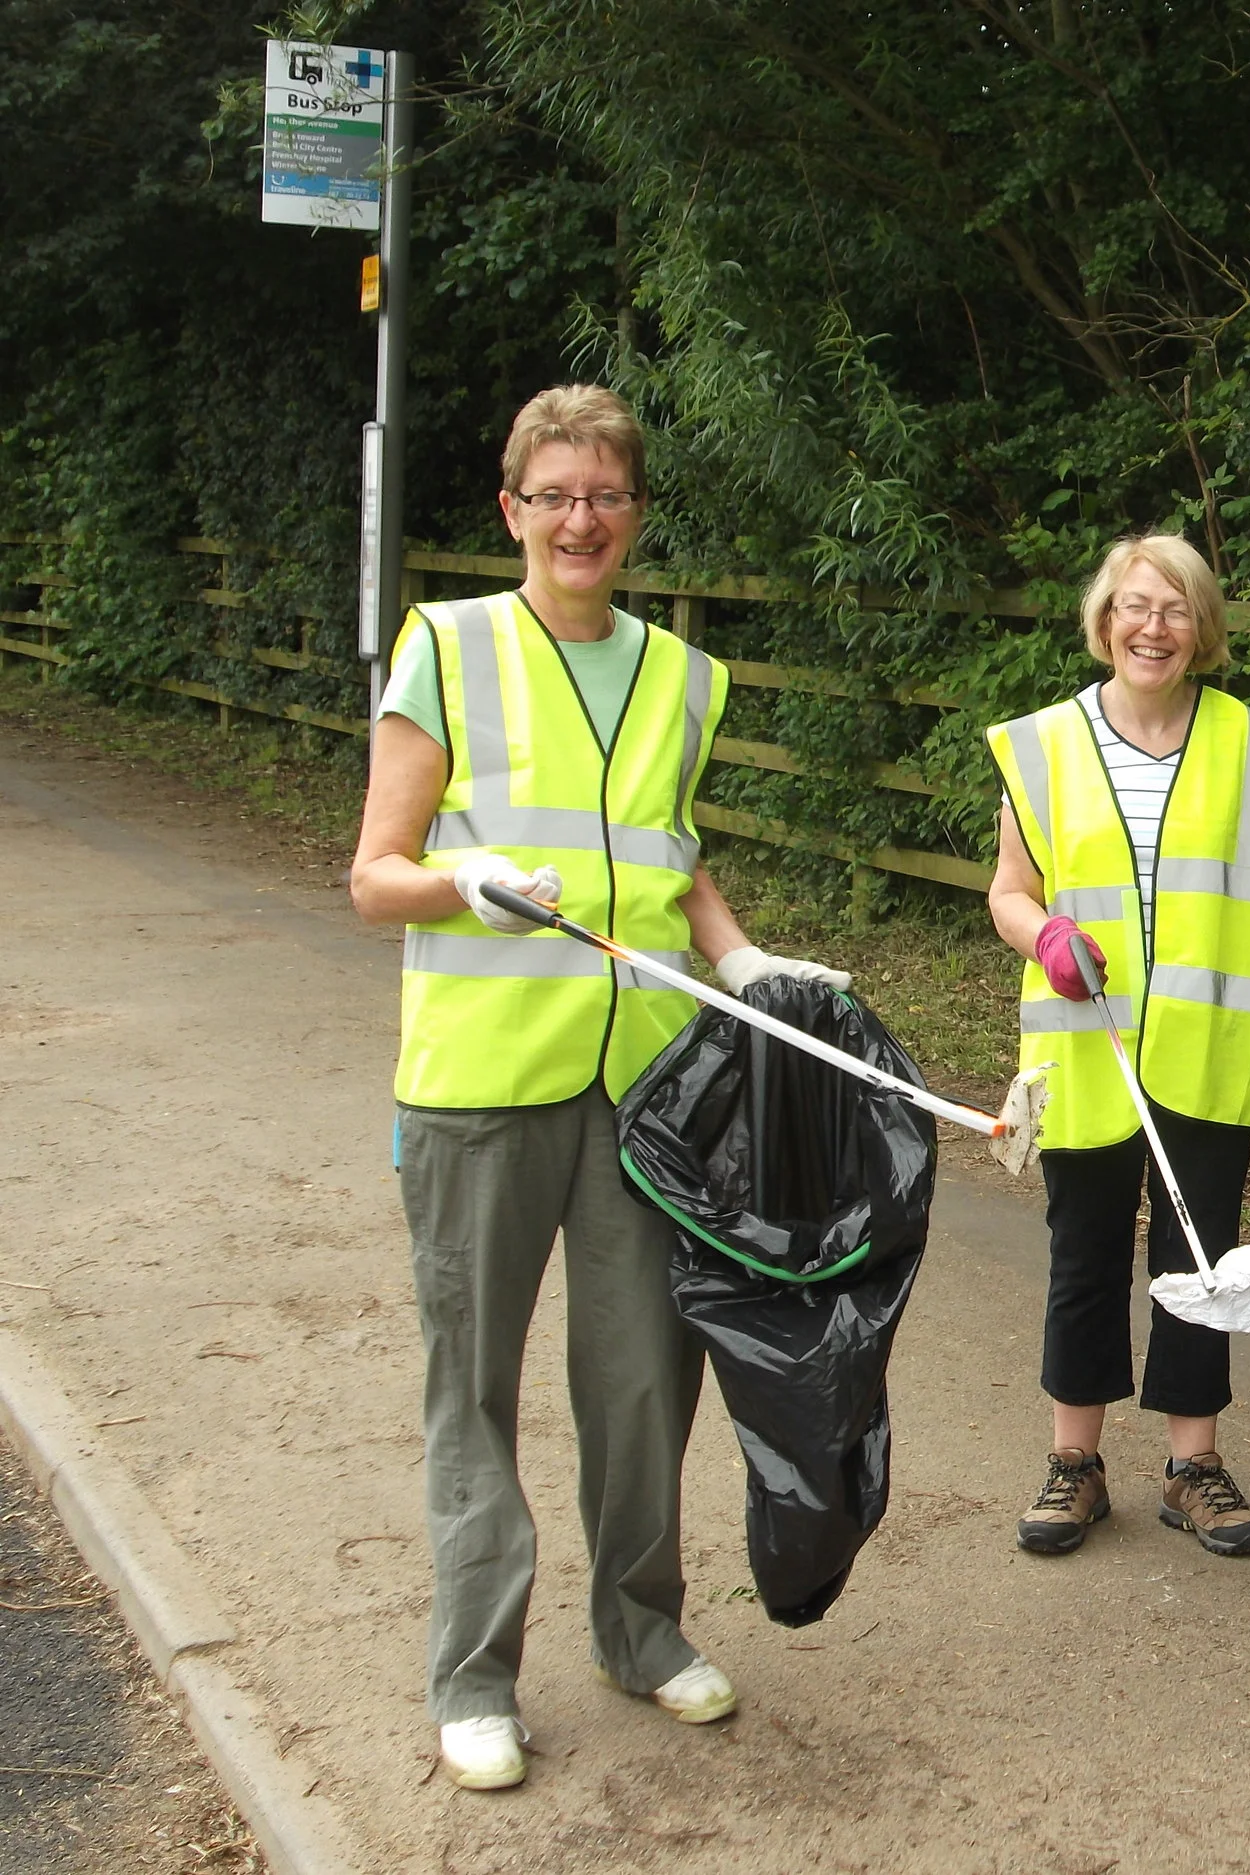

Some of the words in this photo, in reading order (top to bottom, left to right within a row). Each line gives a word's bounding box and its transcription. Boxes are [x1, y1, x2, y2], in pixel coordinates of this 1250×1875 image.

[288, 93, 319, 110] Bus
[272, 140, 298, 150] Brstl
[299, 143, 315, 152] City
[316, 144, 343, 154] Centre
[310, 153, 343, 164] Hospital
